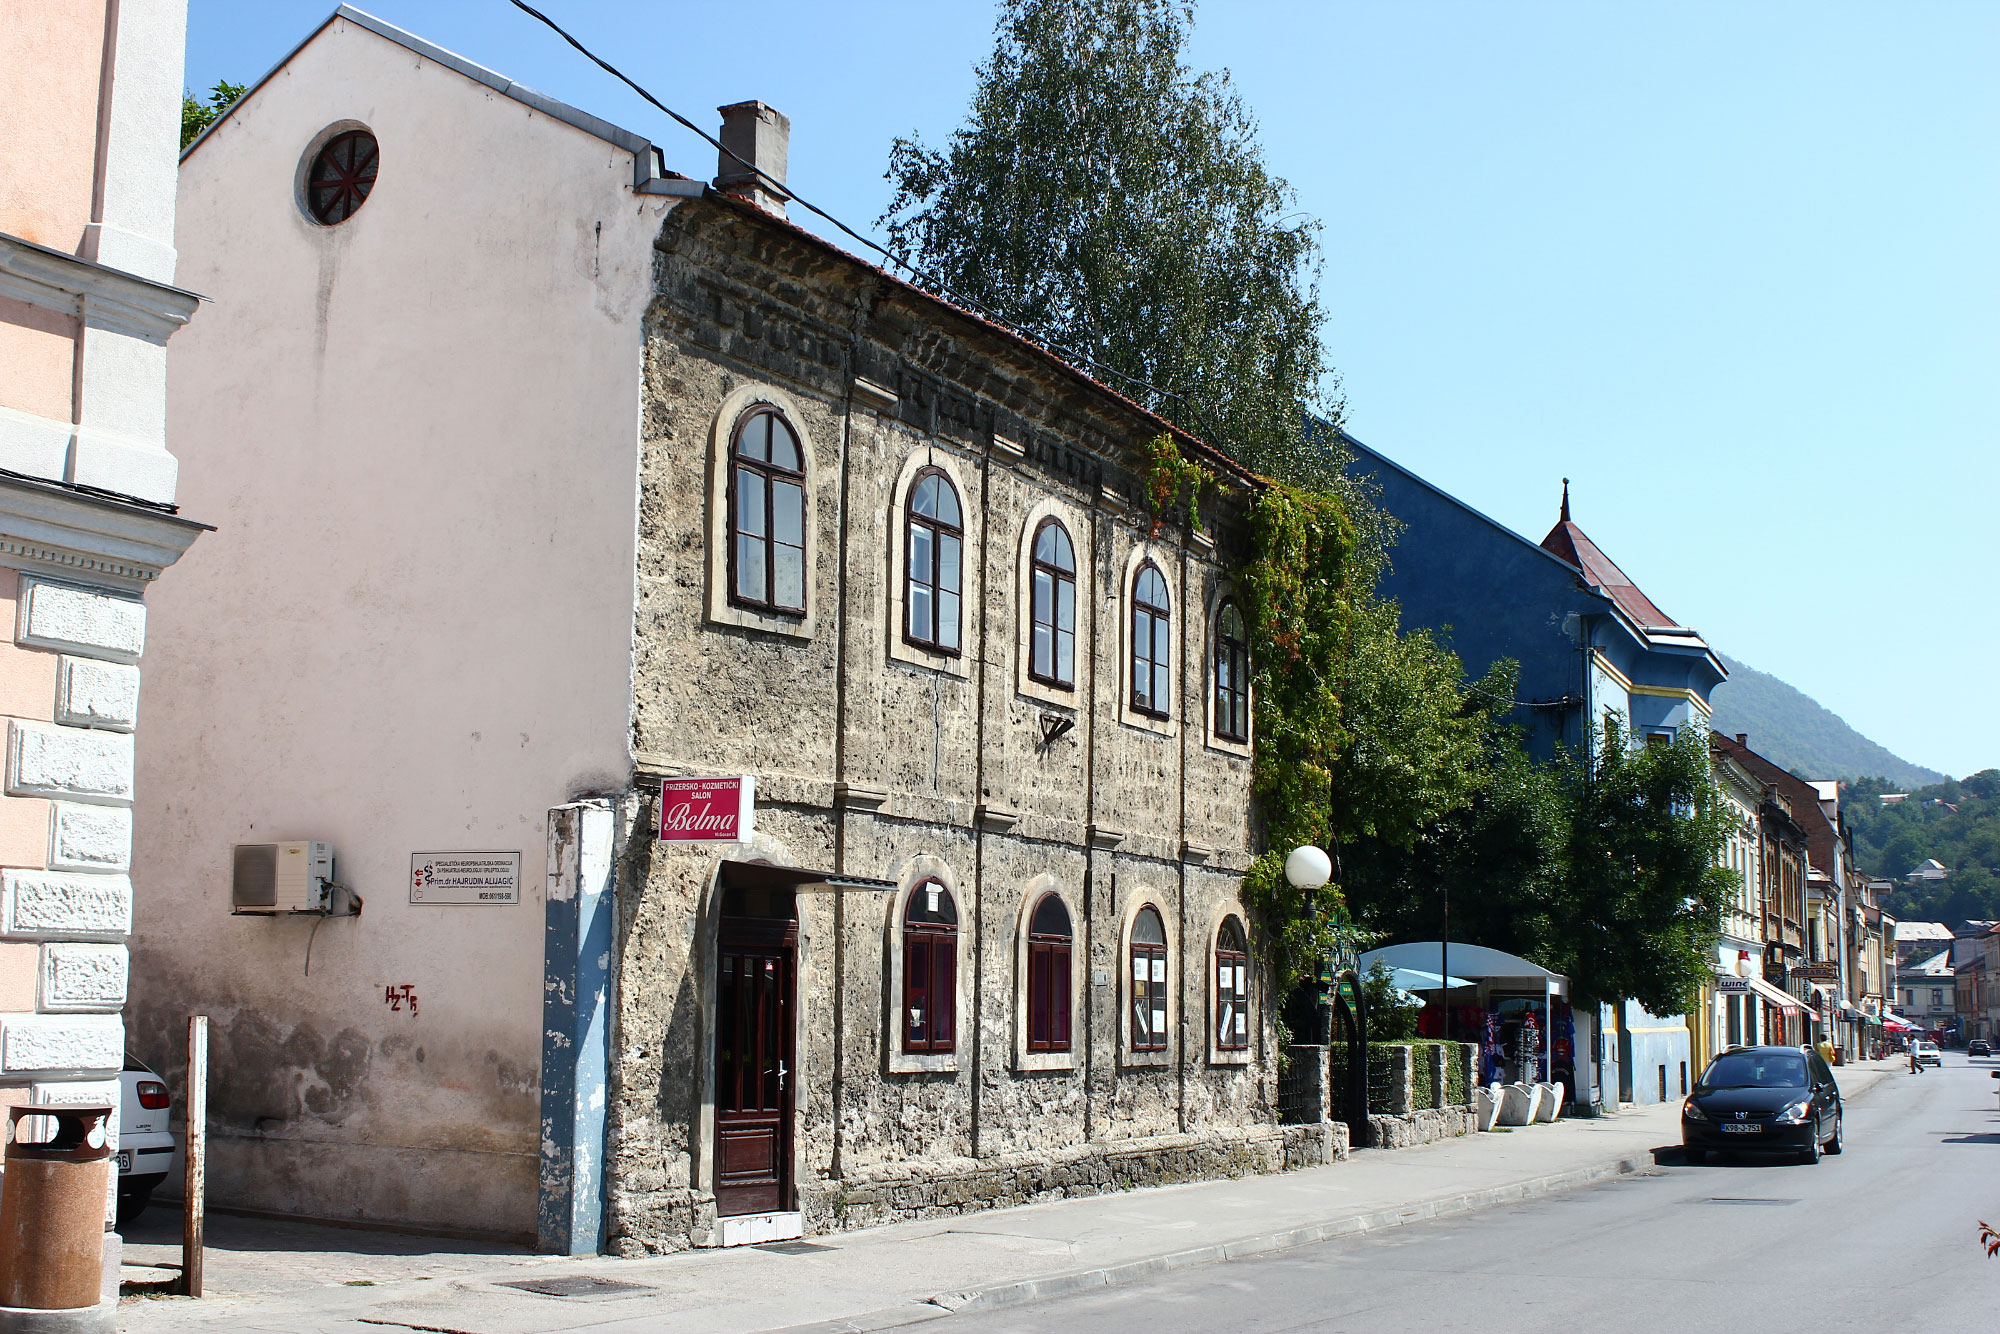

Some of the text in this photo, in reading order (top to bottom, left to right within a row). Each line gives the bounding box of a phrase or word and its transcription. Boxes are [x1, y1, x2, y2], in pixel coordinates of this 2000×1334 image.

[691, 791, 711, 799] SALON
[663, 802, 736, 831] Belma
[453, 877, 484, 885] HAJRUDIN
[485, 876, 513, 885] ALIJAGIĆ
